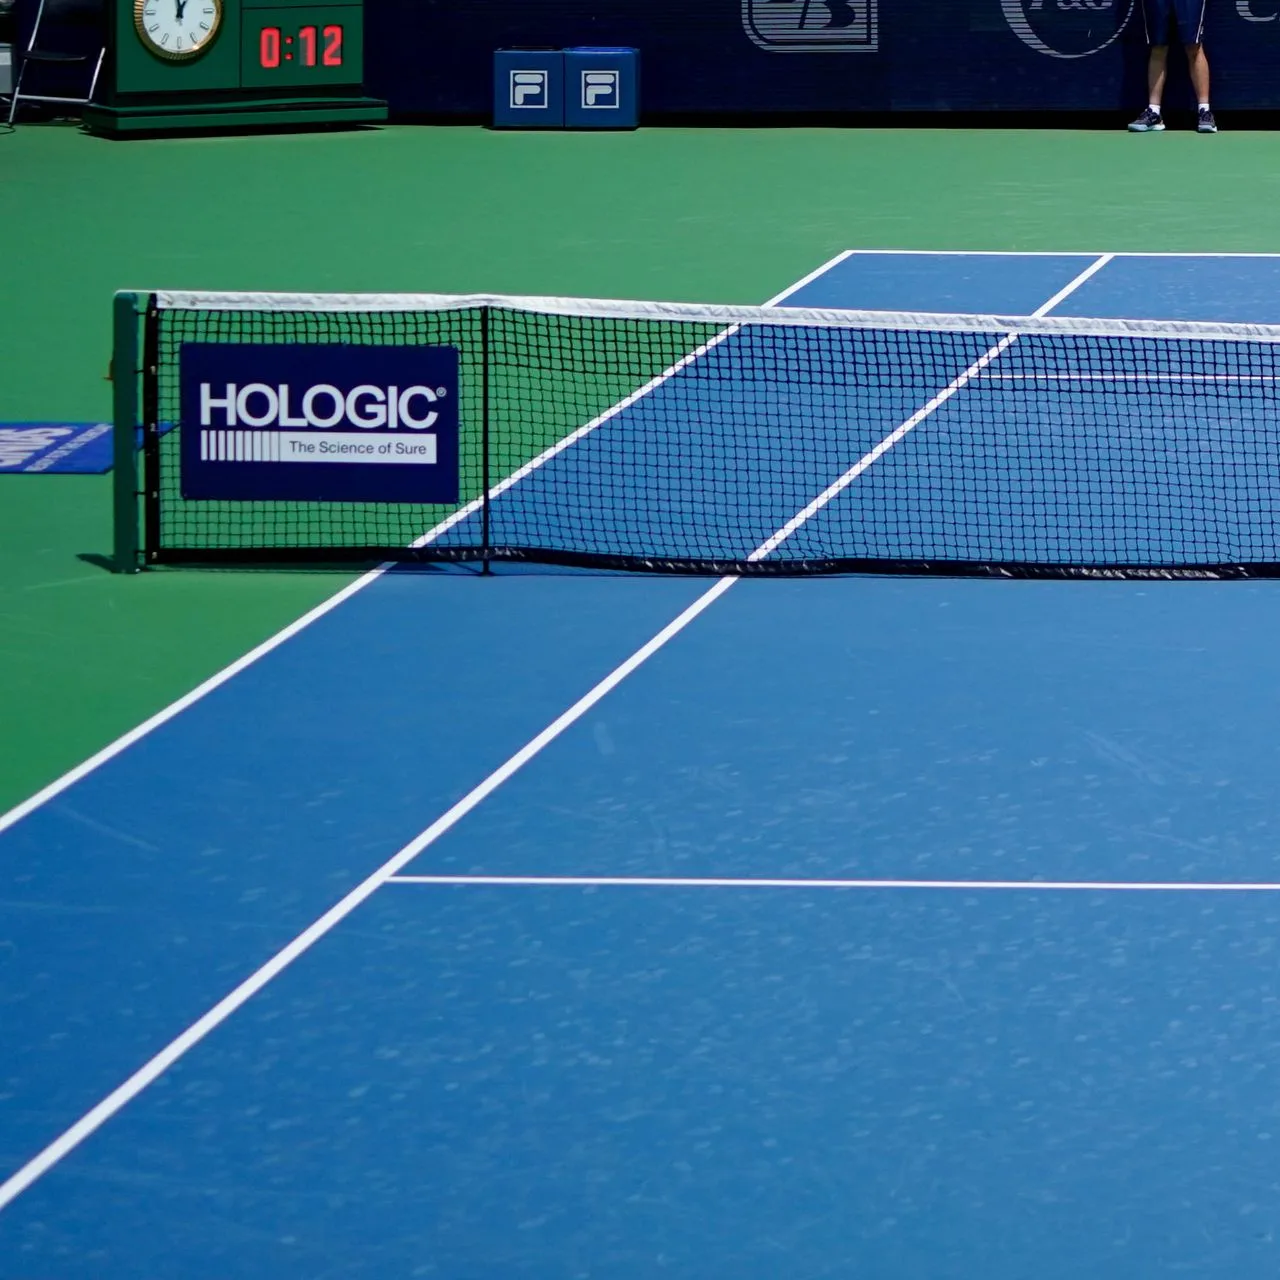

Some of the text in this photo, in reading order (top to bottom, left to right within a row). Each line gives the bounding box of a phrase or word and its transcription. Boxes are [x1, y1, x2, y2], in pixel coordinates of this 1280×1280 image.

[259, 24, 344, 68] 0:12
[289, 441, 427, 455] The Science of Sure
